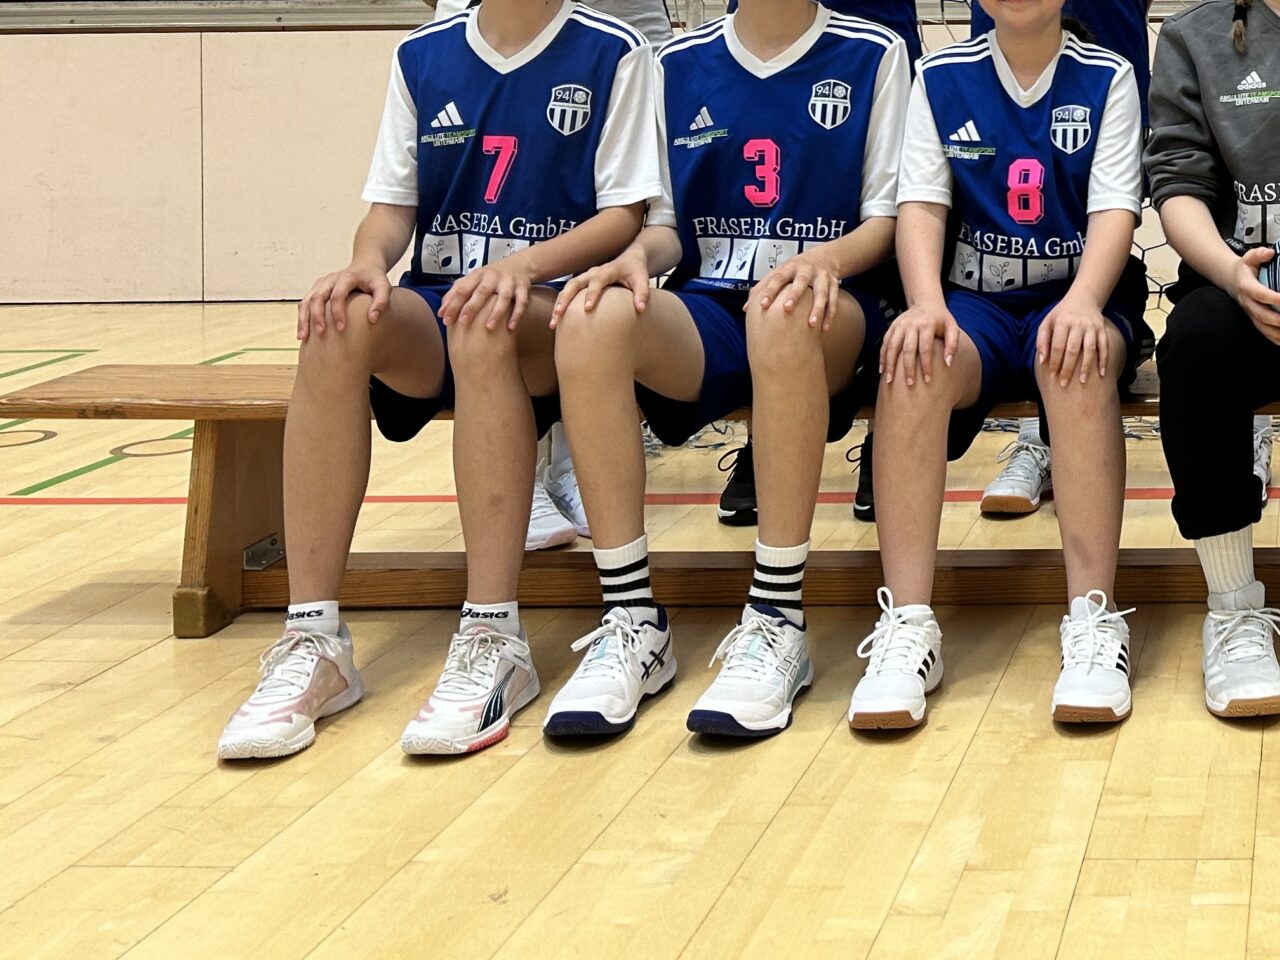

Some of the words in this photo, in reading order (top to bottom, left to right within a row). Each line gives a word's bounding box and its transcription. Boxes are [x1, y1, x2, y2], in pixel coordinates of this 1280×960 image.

[555, 90, 570, 101] 94
[816, 85, 831, 96] 94
[1237, 82, 1267, 90] adidas
[1056, 111, 1070, 121] 94
[483, 135, 518, 204] 7
[743, 138, 780, 208] 3
[1007, 158, 1044, 225] 8
[431, 212, 504, 235] RASEBA
[509, 216, 576, 239] GmbH
[692, 217, 771, 237] FRASEBA
[776, 217, 847, 239] GmbH
[1044, 231, 1086, 257] Gmb
